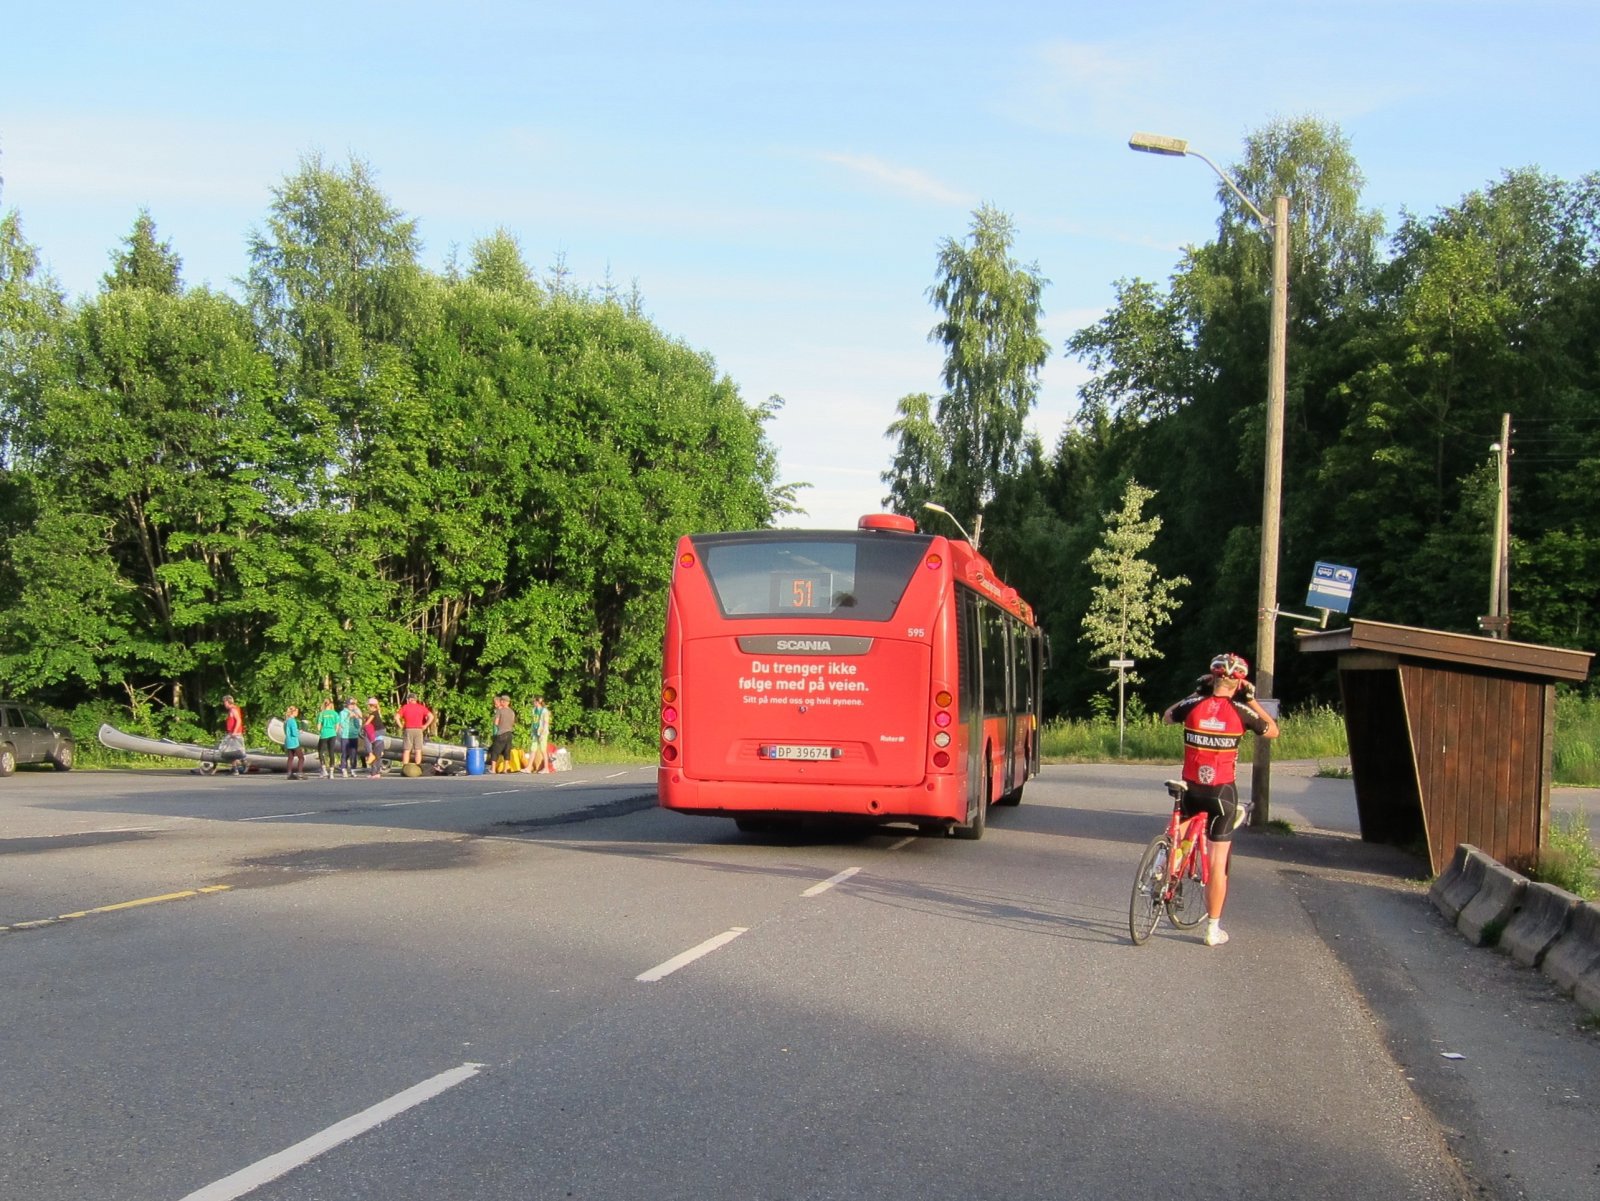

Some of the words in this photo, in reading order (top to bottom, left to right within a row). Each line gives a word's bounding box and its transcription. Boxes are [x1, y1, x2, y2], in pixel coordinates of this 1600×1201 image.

[792, 579, 813, 607] 51
[907, 628, 925, 638] 595
[776, 640, 831, 651] SCANIA
[752, 661, 770, 673] Du
[773, 662, 824, 677] trenger
[828, 662, 857, 675] ikke
[739, 677, 772, 692] følge
[776, 678, 805, 690] med
[808, 676, 825, 693] på
[829, 679, 869, 692] veien.
[743, 696, 757, 704] Sitt
[758, 695, 769, 705] på
[789, 697, 803, 705] oss
[804, 698, 815, 706] og
[816, 697, 831, 705] hvil
[778, 747, 792, 758] DP
[796, 747, 829, 758] 39674
